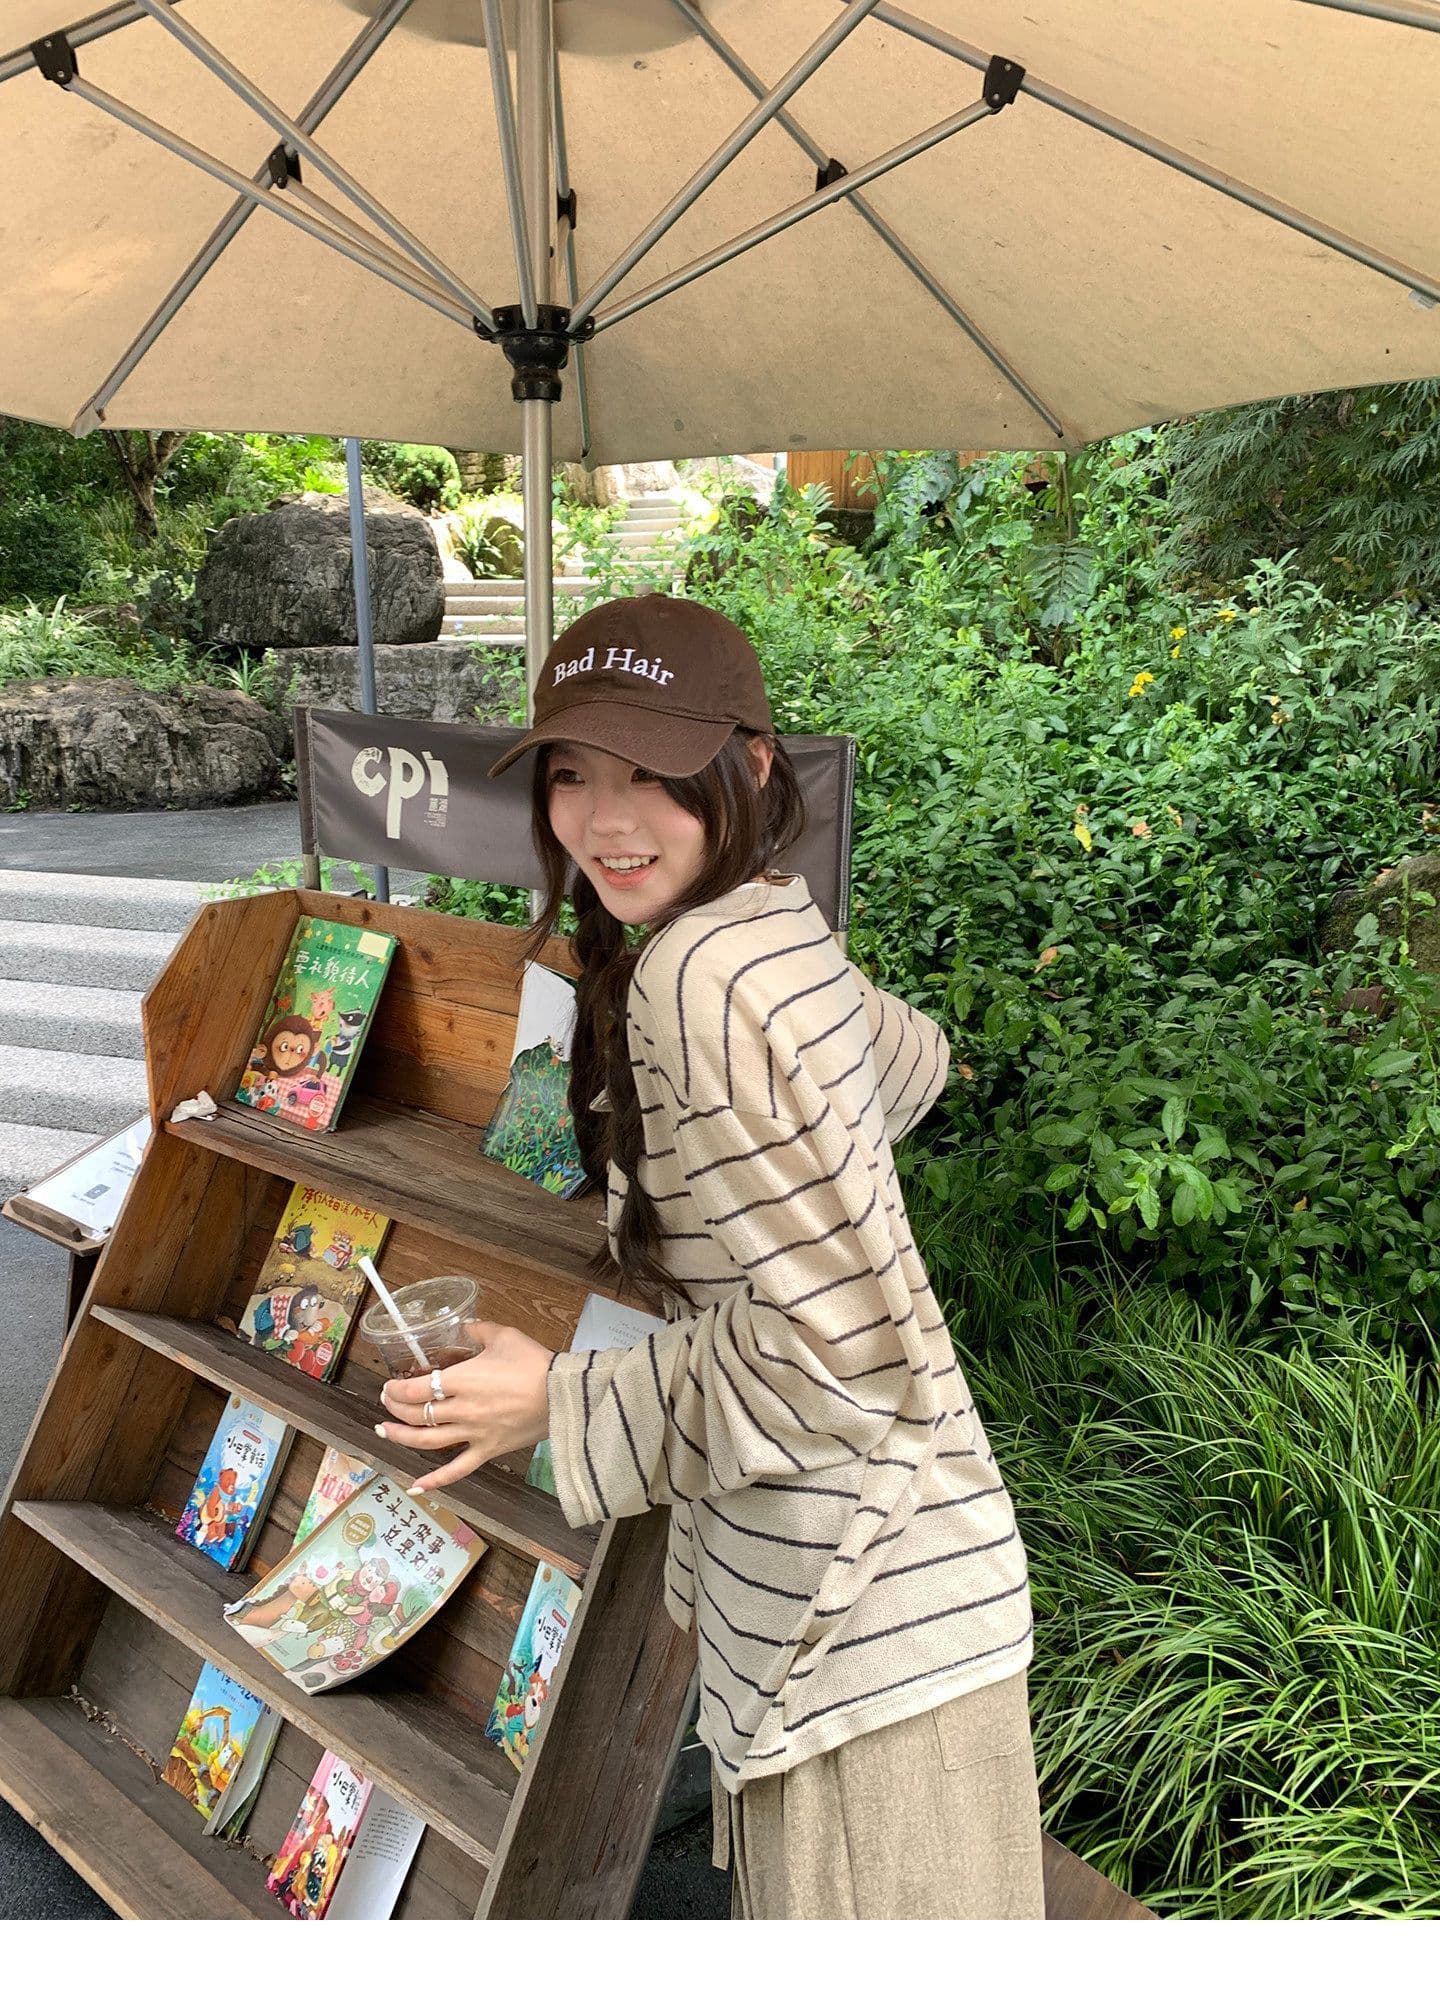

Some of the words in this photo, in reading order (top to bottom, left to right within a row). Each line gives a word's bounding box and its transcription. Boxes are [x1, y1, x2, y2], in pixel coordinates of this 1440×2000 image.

[552, 647, 595, 687] Bad
[601, 647, 675, 686] Hair
[294, 950, 370, 989] 要礼貌待人
[227, 1435, 266, 1469] 小巴掌童话
[371, 1482, 446, 1556] 老头子做事
[380, 1523, 446, 1585] 总是对的
[537, 1615, 564, 1655] 小巴掌童
